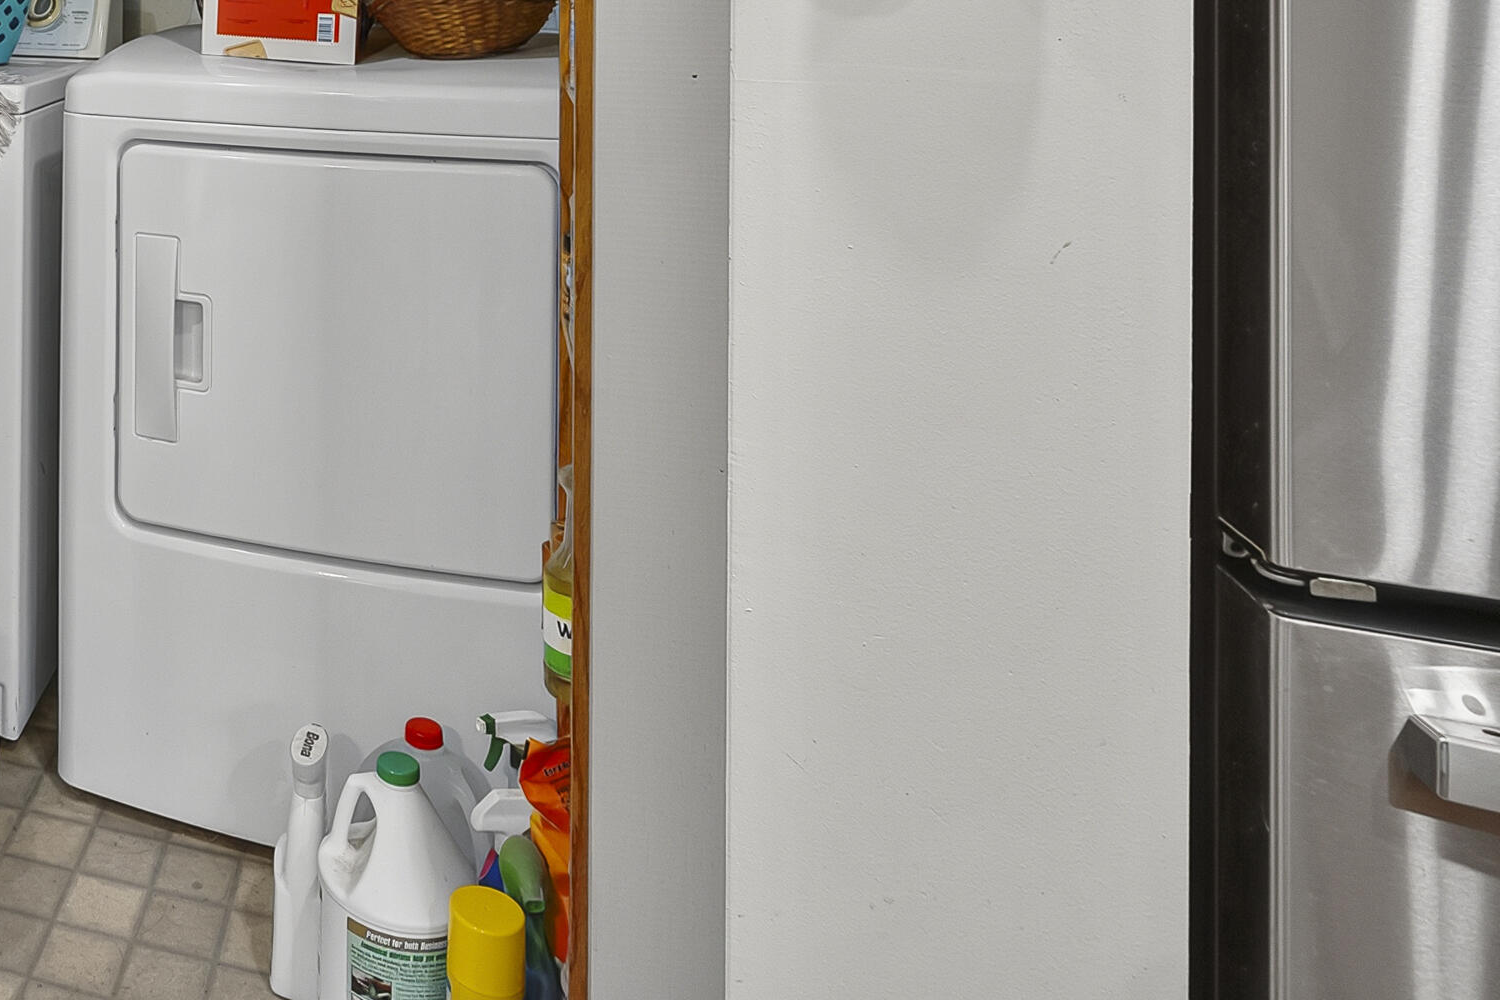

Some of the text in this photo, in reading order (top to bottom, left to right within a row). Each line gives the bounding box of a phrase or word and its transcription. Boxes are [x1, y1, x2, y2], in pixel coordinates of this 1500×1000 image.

[300, 731, 320, 758] Bona
[366, 930, 391, 947] Perfect
[392, 939, 403, 949] for
[404, 941, 419, 951] both
